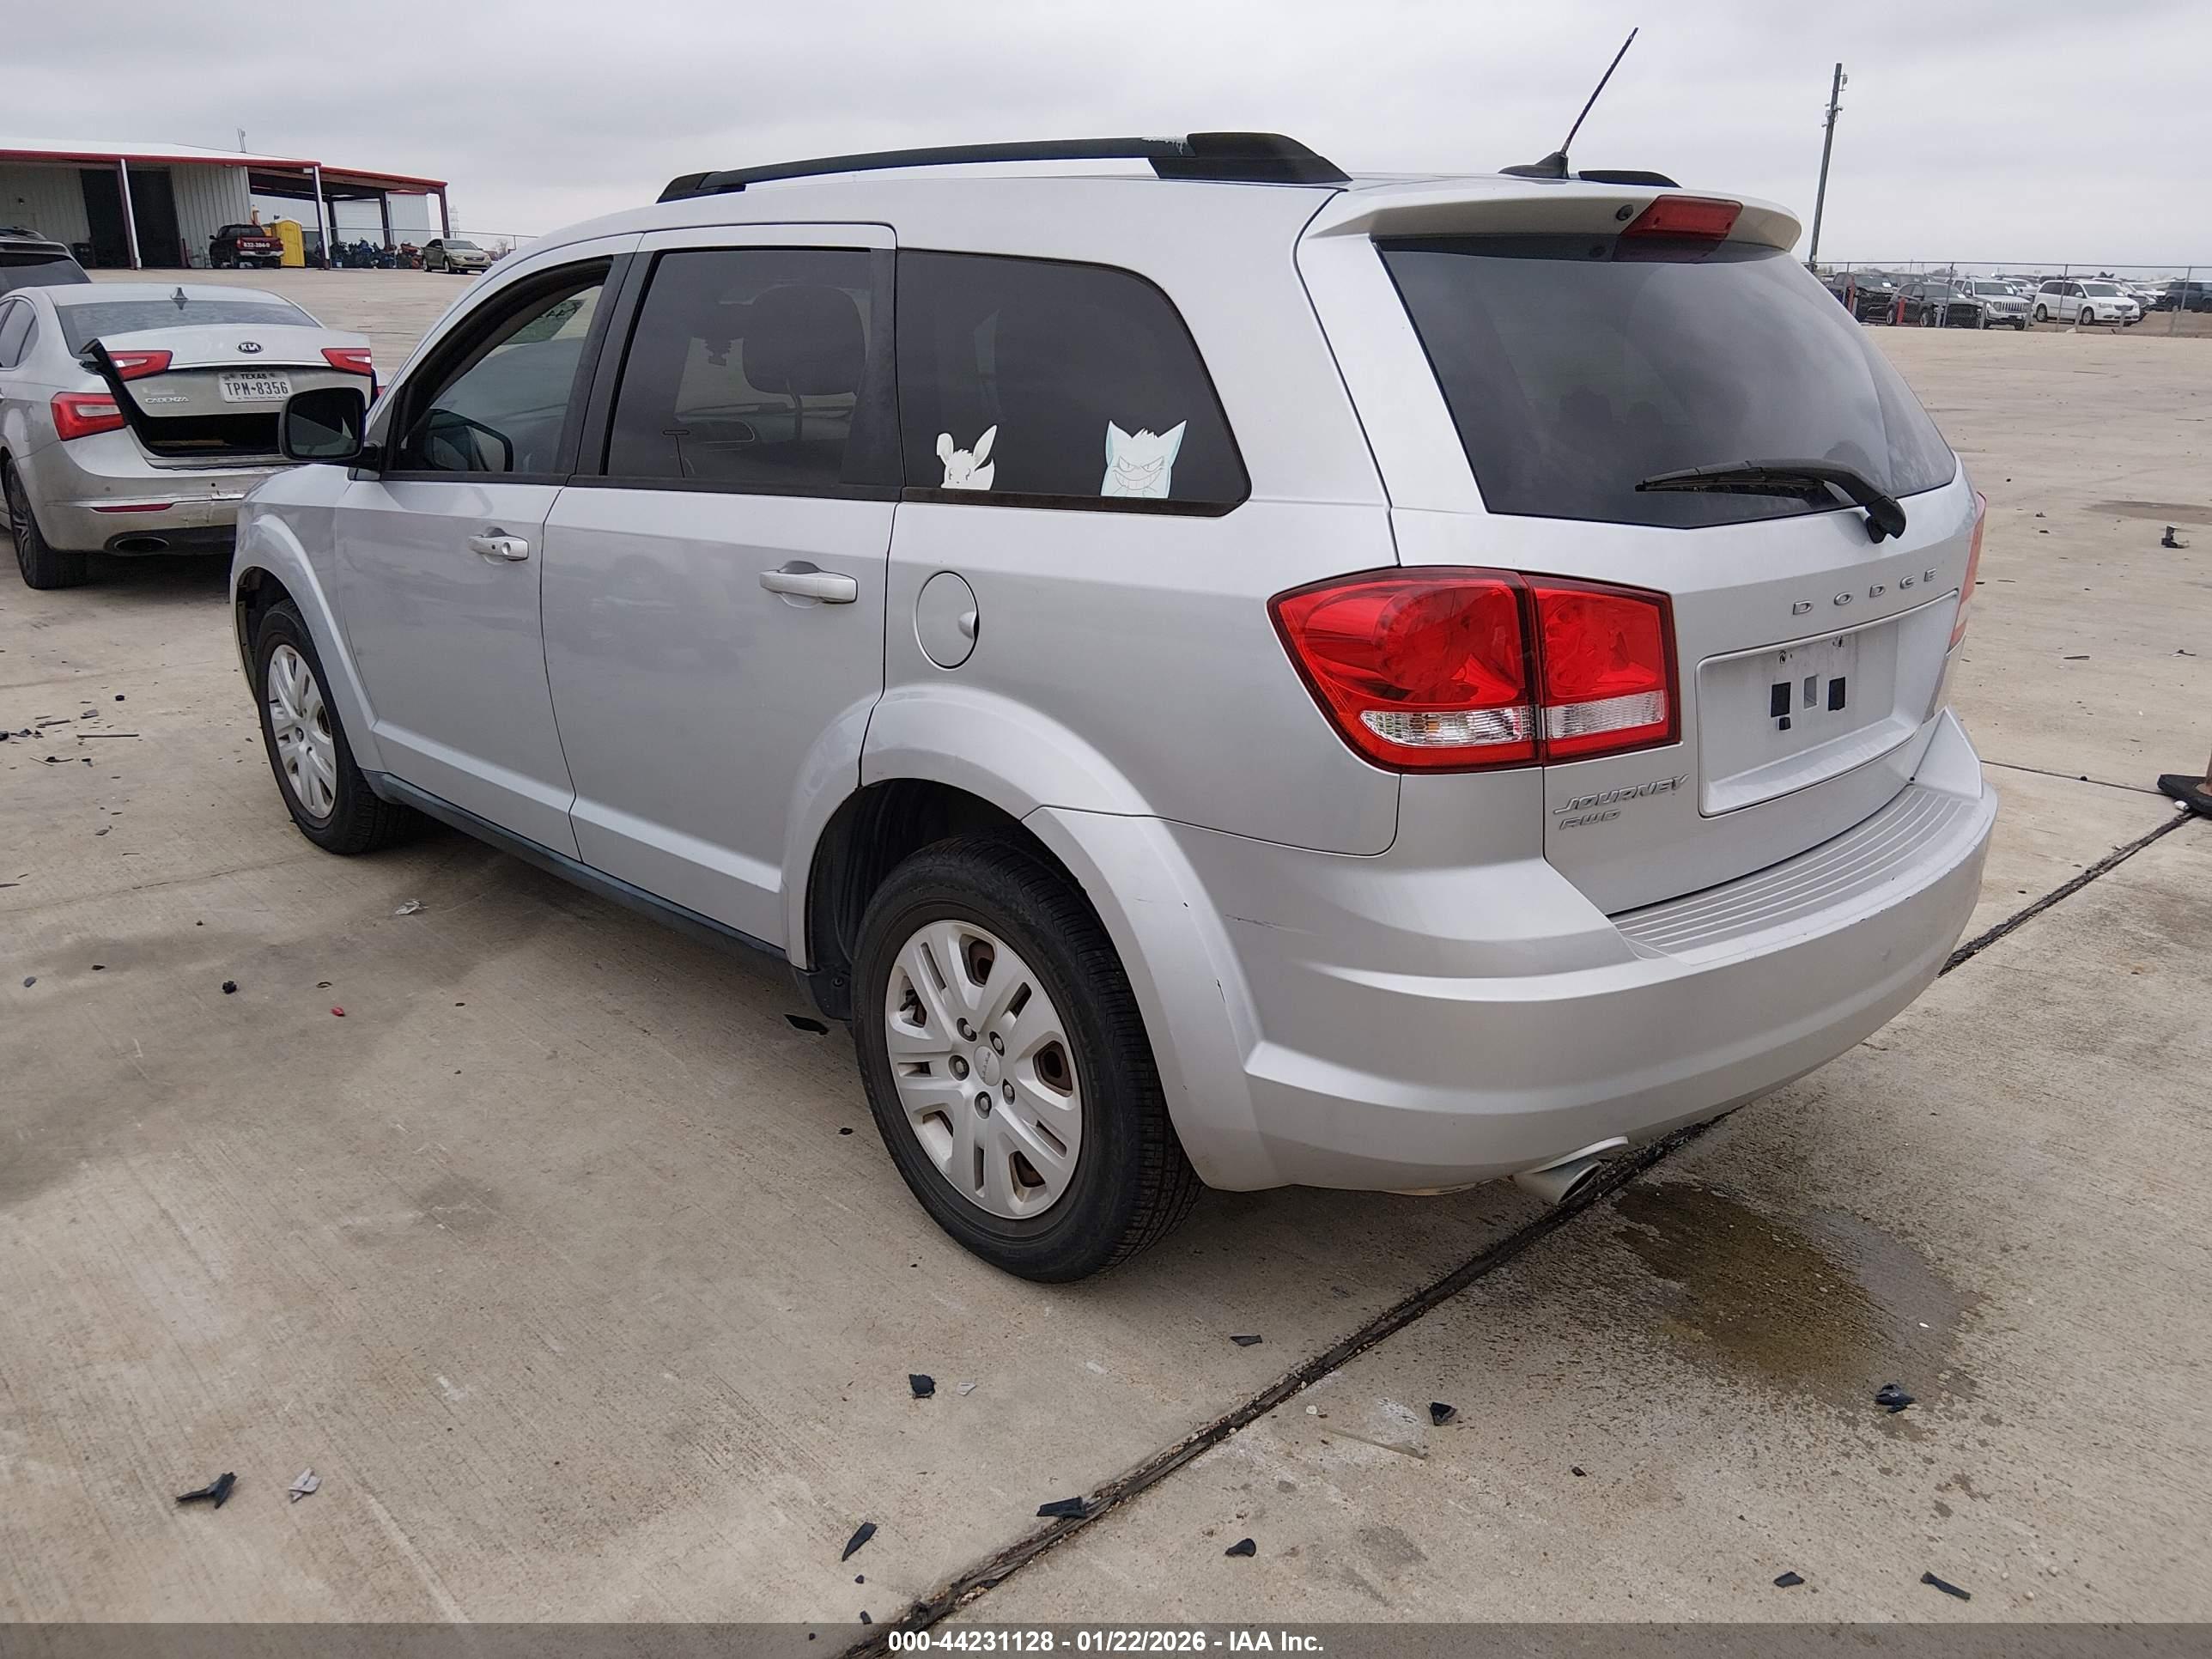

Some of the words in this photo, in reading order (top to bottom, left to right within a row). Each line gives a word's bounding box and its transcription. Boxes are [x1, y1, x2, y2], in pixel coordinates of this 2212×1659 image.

[240, 343, 260, 351] KIA
[1791, 567, 1938, 616] DODGE
[1553, 773, 1690, 815] JOURNEY
